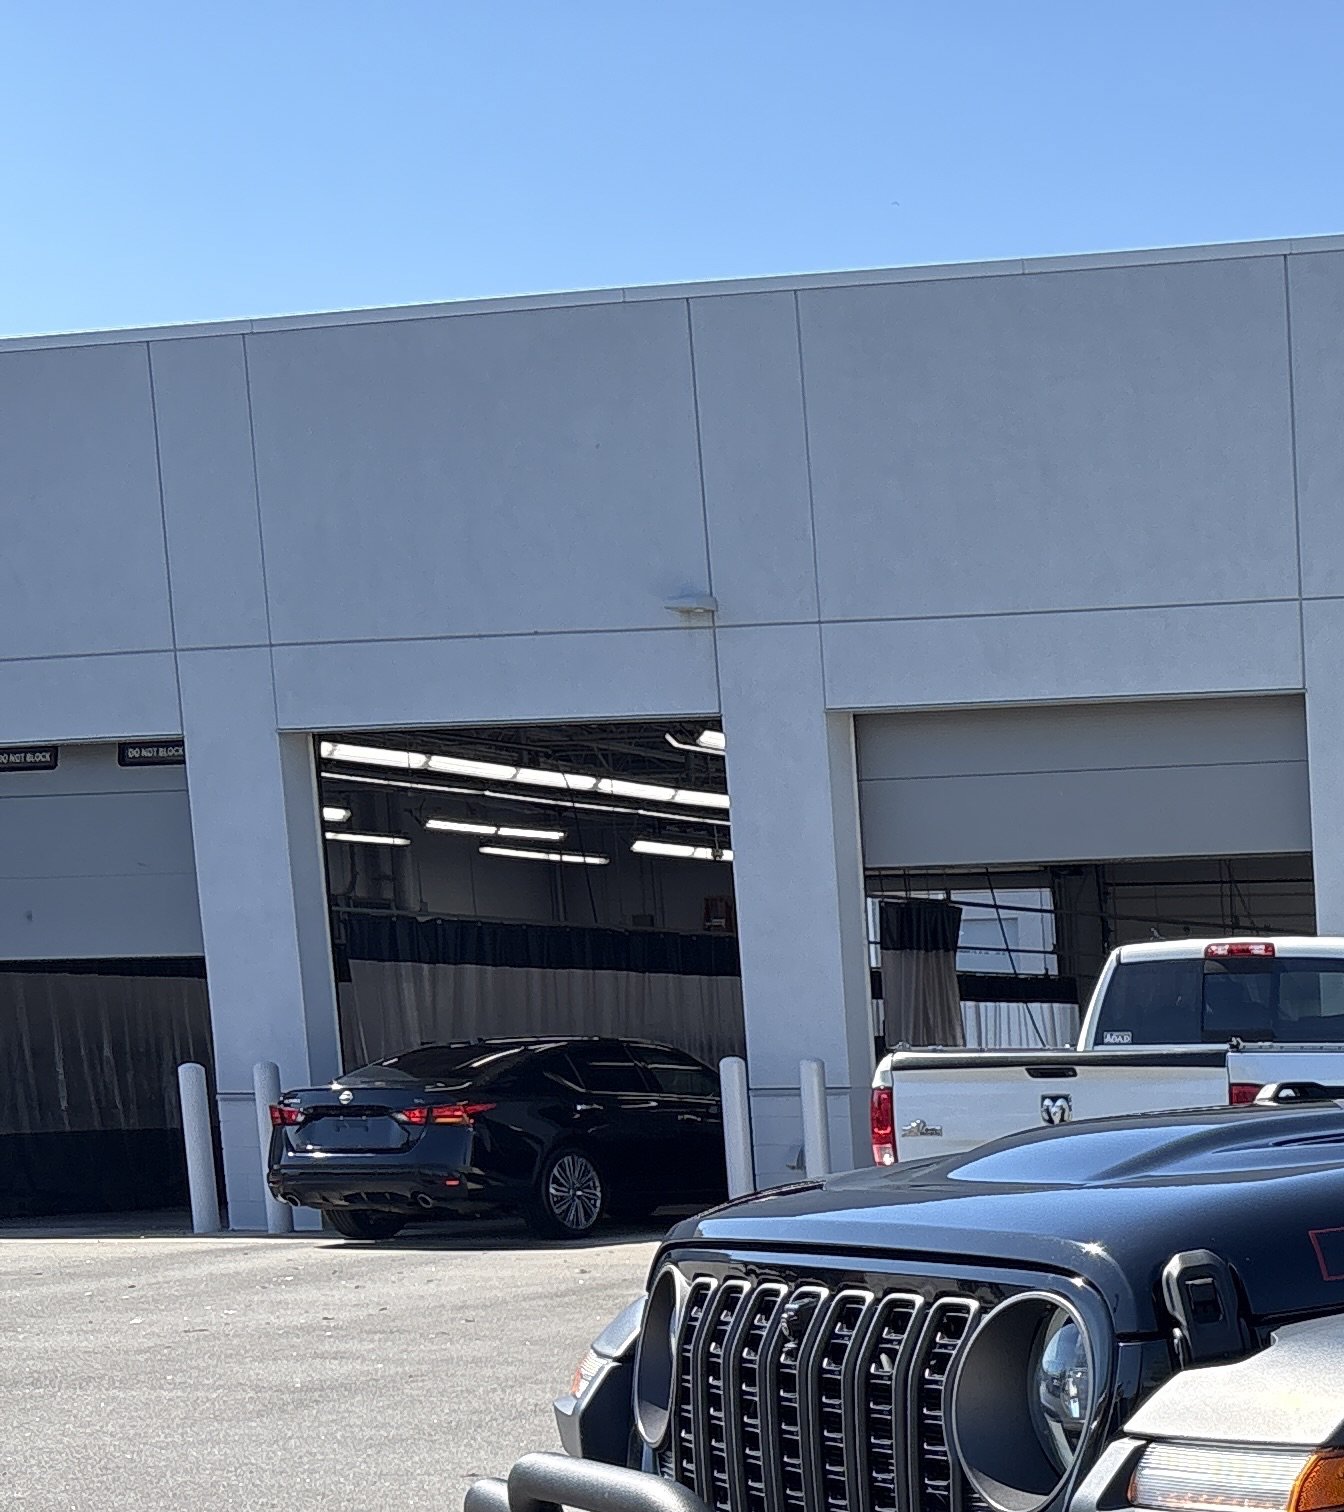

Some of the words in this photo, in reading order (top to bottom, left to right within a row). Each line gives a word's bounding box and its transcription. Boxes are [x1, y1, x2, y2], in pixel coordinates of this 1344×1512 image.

[9, 752, 25, 763] NOT
[26, 751, 51, 762] BLOCK
[128, 747, 140, 758] DO
[141, 746, 158, 757] NOT
[158, 745, 184, 756] BLOCK
